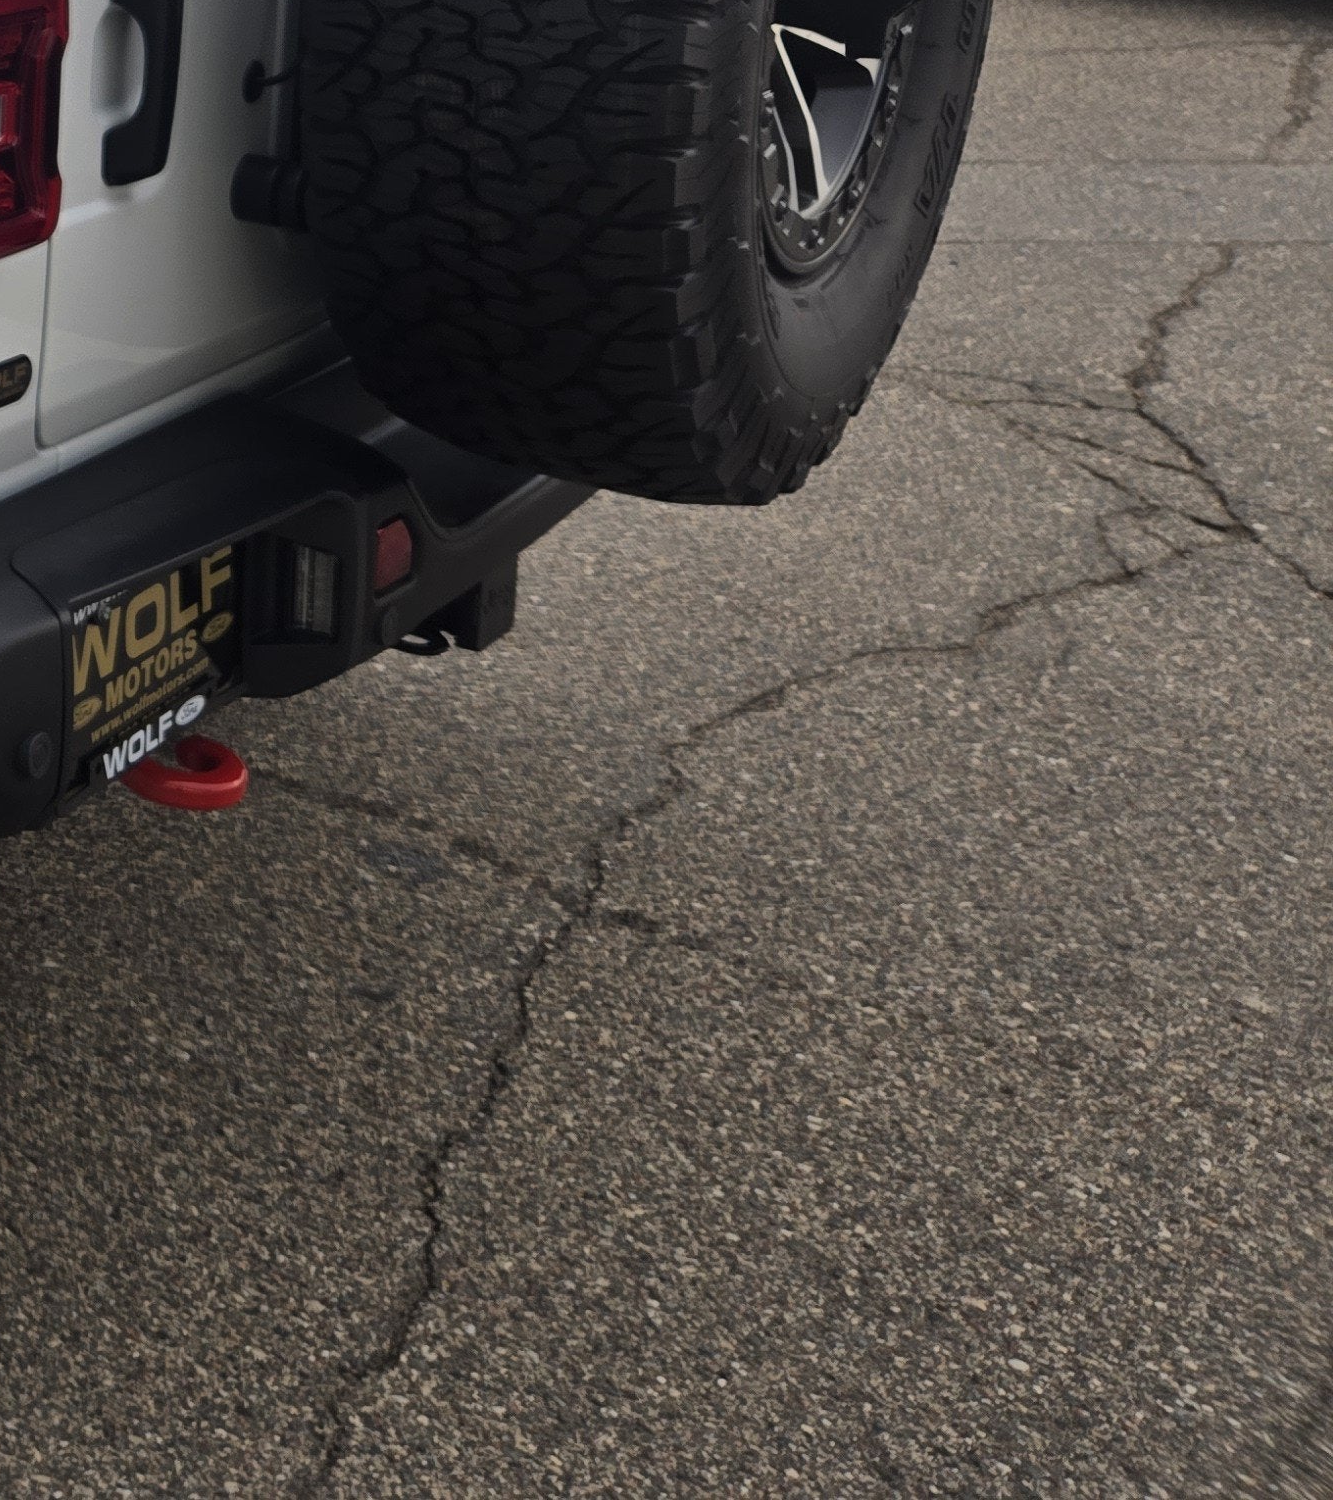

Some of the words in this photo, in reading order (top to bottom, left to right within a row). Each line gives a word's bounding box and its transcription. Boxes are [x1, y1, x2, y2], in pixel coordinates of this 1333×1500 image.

[72, 545, 233, 694] WOLF
[91, 657, 210, 743] www.wolfmotors.com
[105, 629, 197, 713] MOTORS
[103, 709, 173, 780] WOLF
